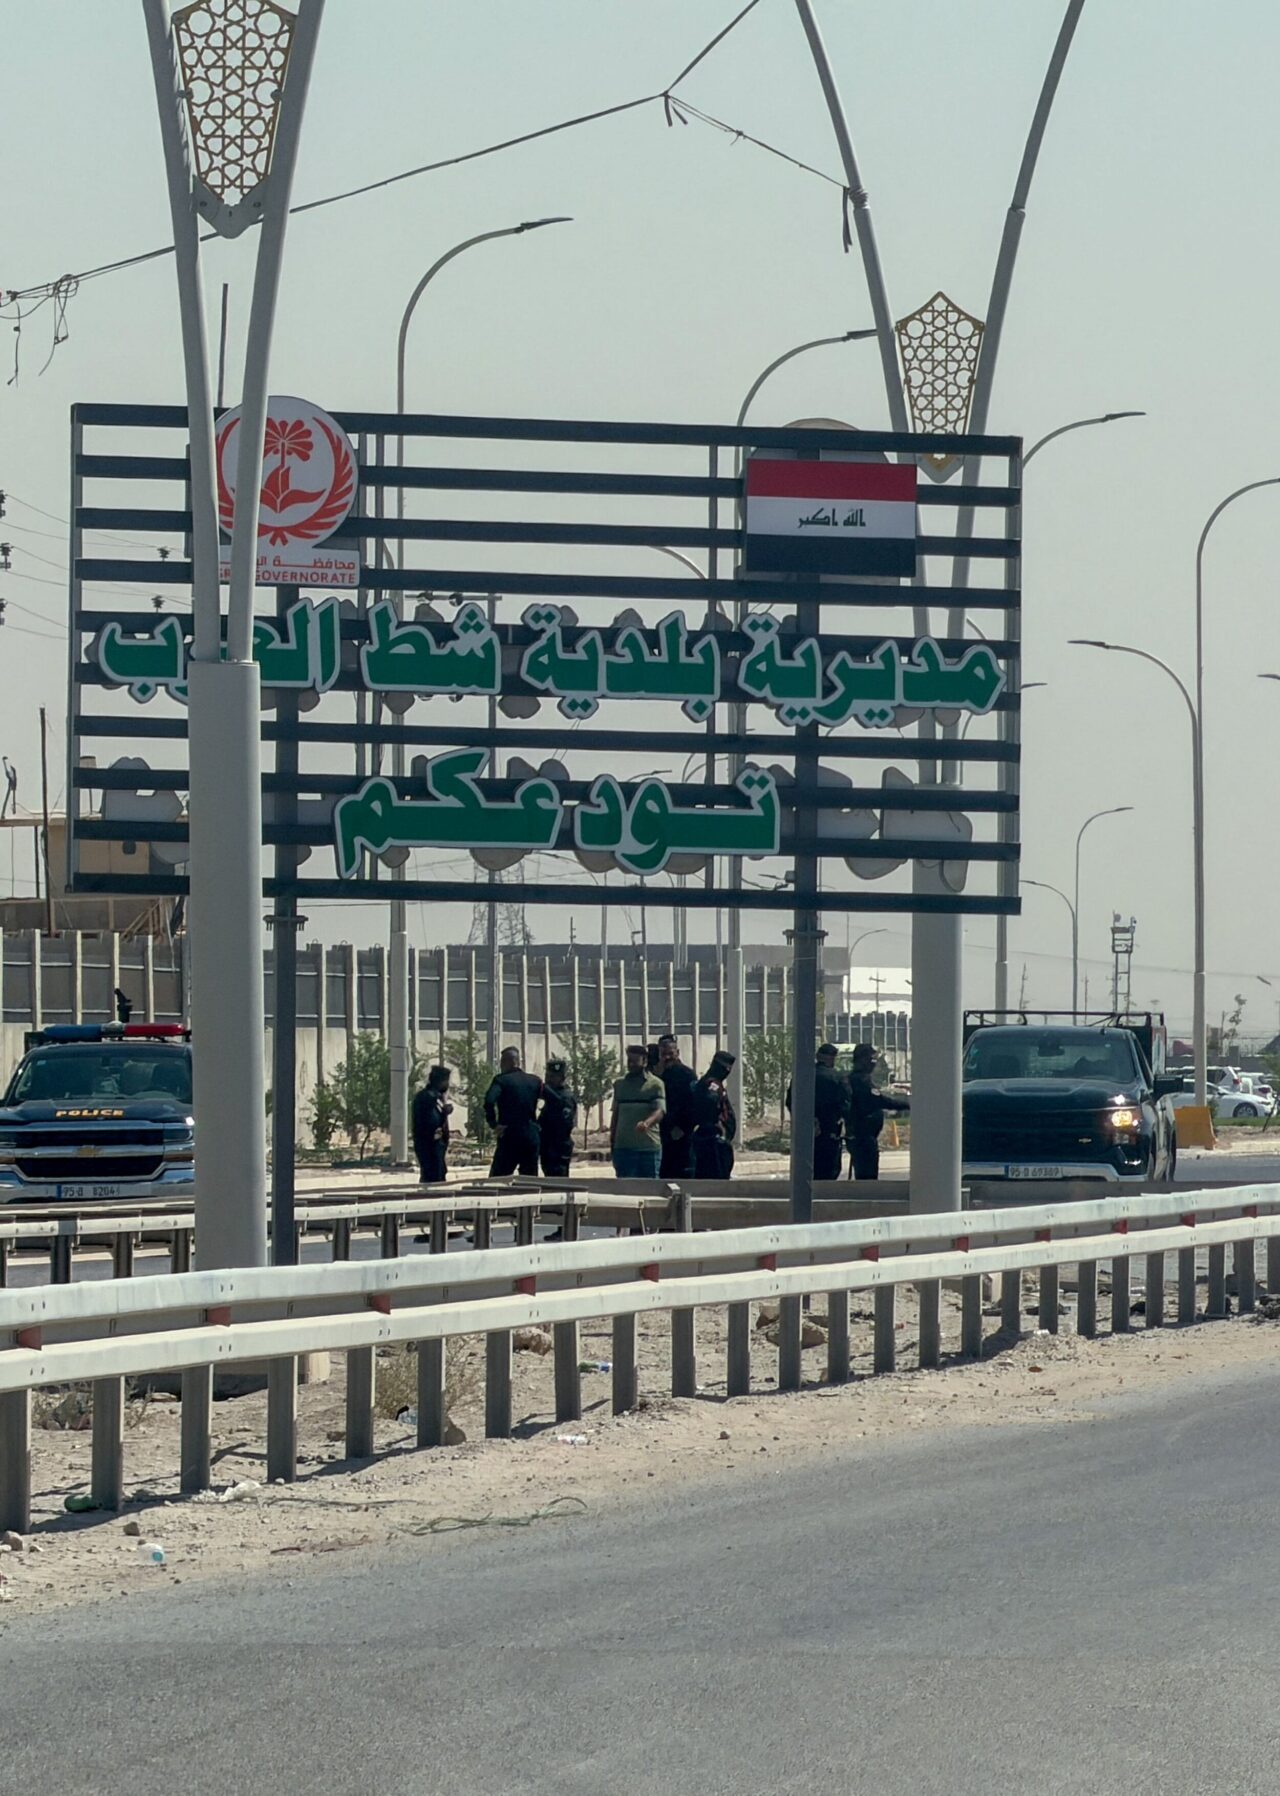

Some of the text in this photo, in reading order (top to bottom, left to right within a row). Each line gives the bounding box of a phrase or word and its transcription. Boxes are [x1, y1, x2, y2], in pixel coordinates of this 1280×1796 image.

[256, 570, 356, 584] GOVERNORATE
[101, 598, 1004, 726] مديرية بلدية شط العب
[55, 1108, 124, 1118] POLICE
